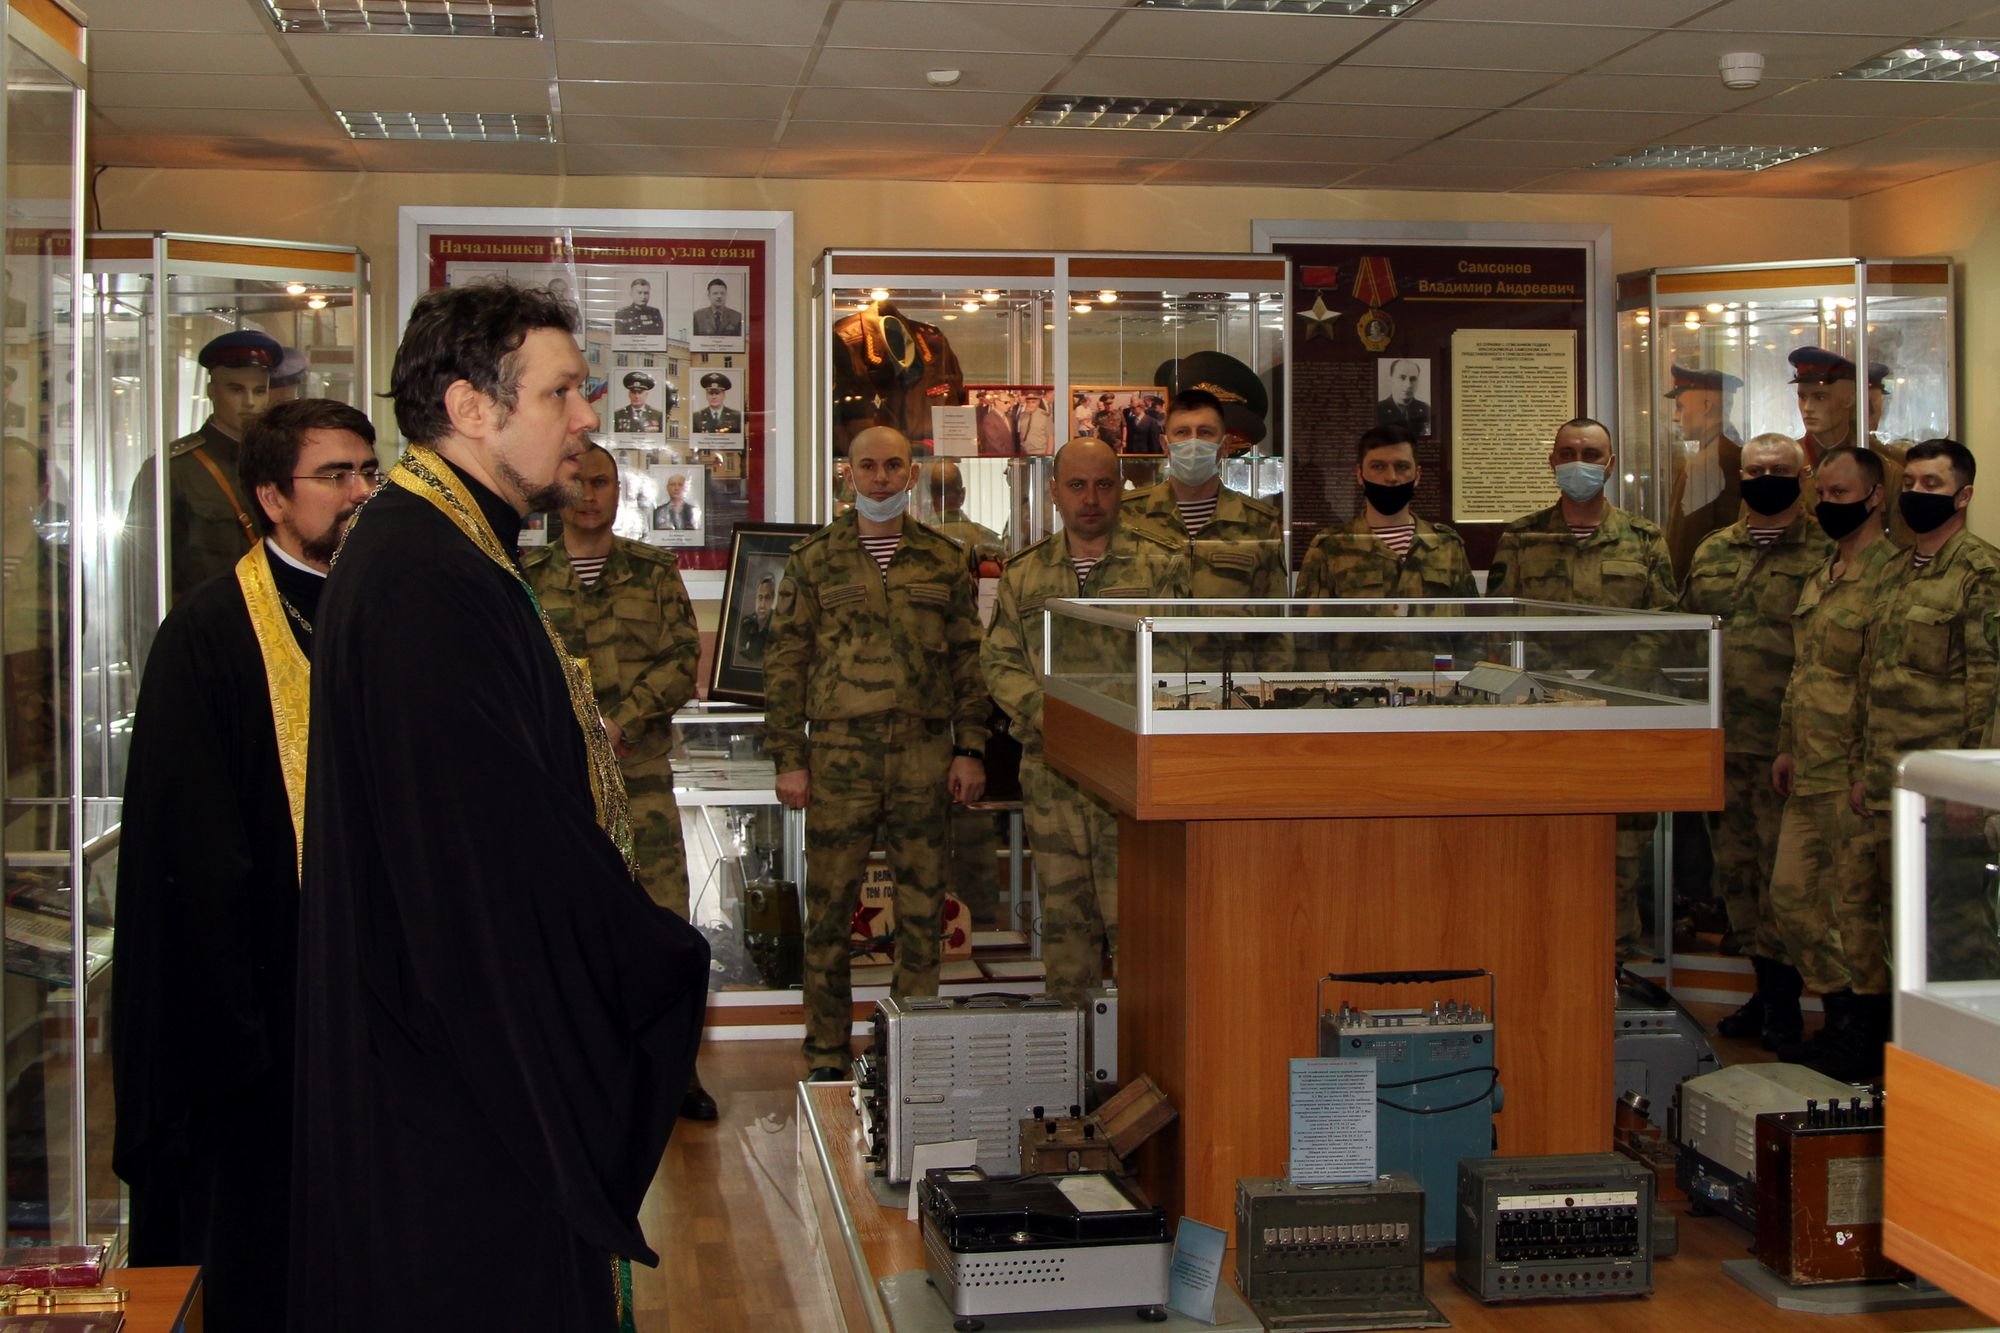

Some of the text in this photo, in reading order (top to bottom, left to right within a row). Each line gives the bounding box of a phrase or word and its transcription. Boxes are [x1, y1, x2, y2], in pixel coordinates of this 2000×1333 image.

[439, 239, 756, 261] Начальники Центрального узла связи
[1458, 260, 1532, 274] Самсонов
[1418, 279, 1575, 297] Владимир Андреевич
